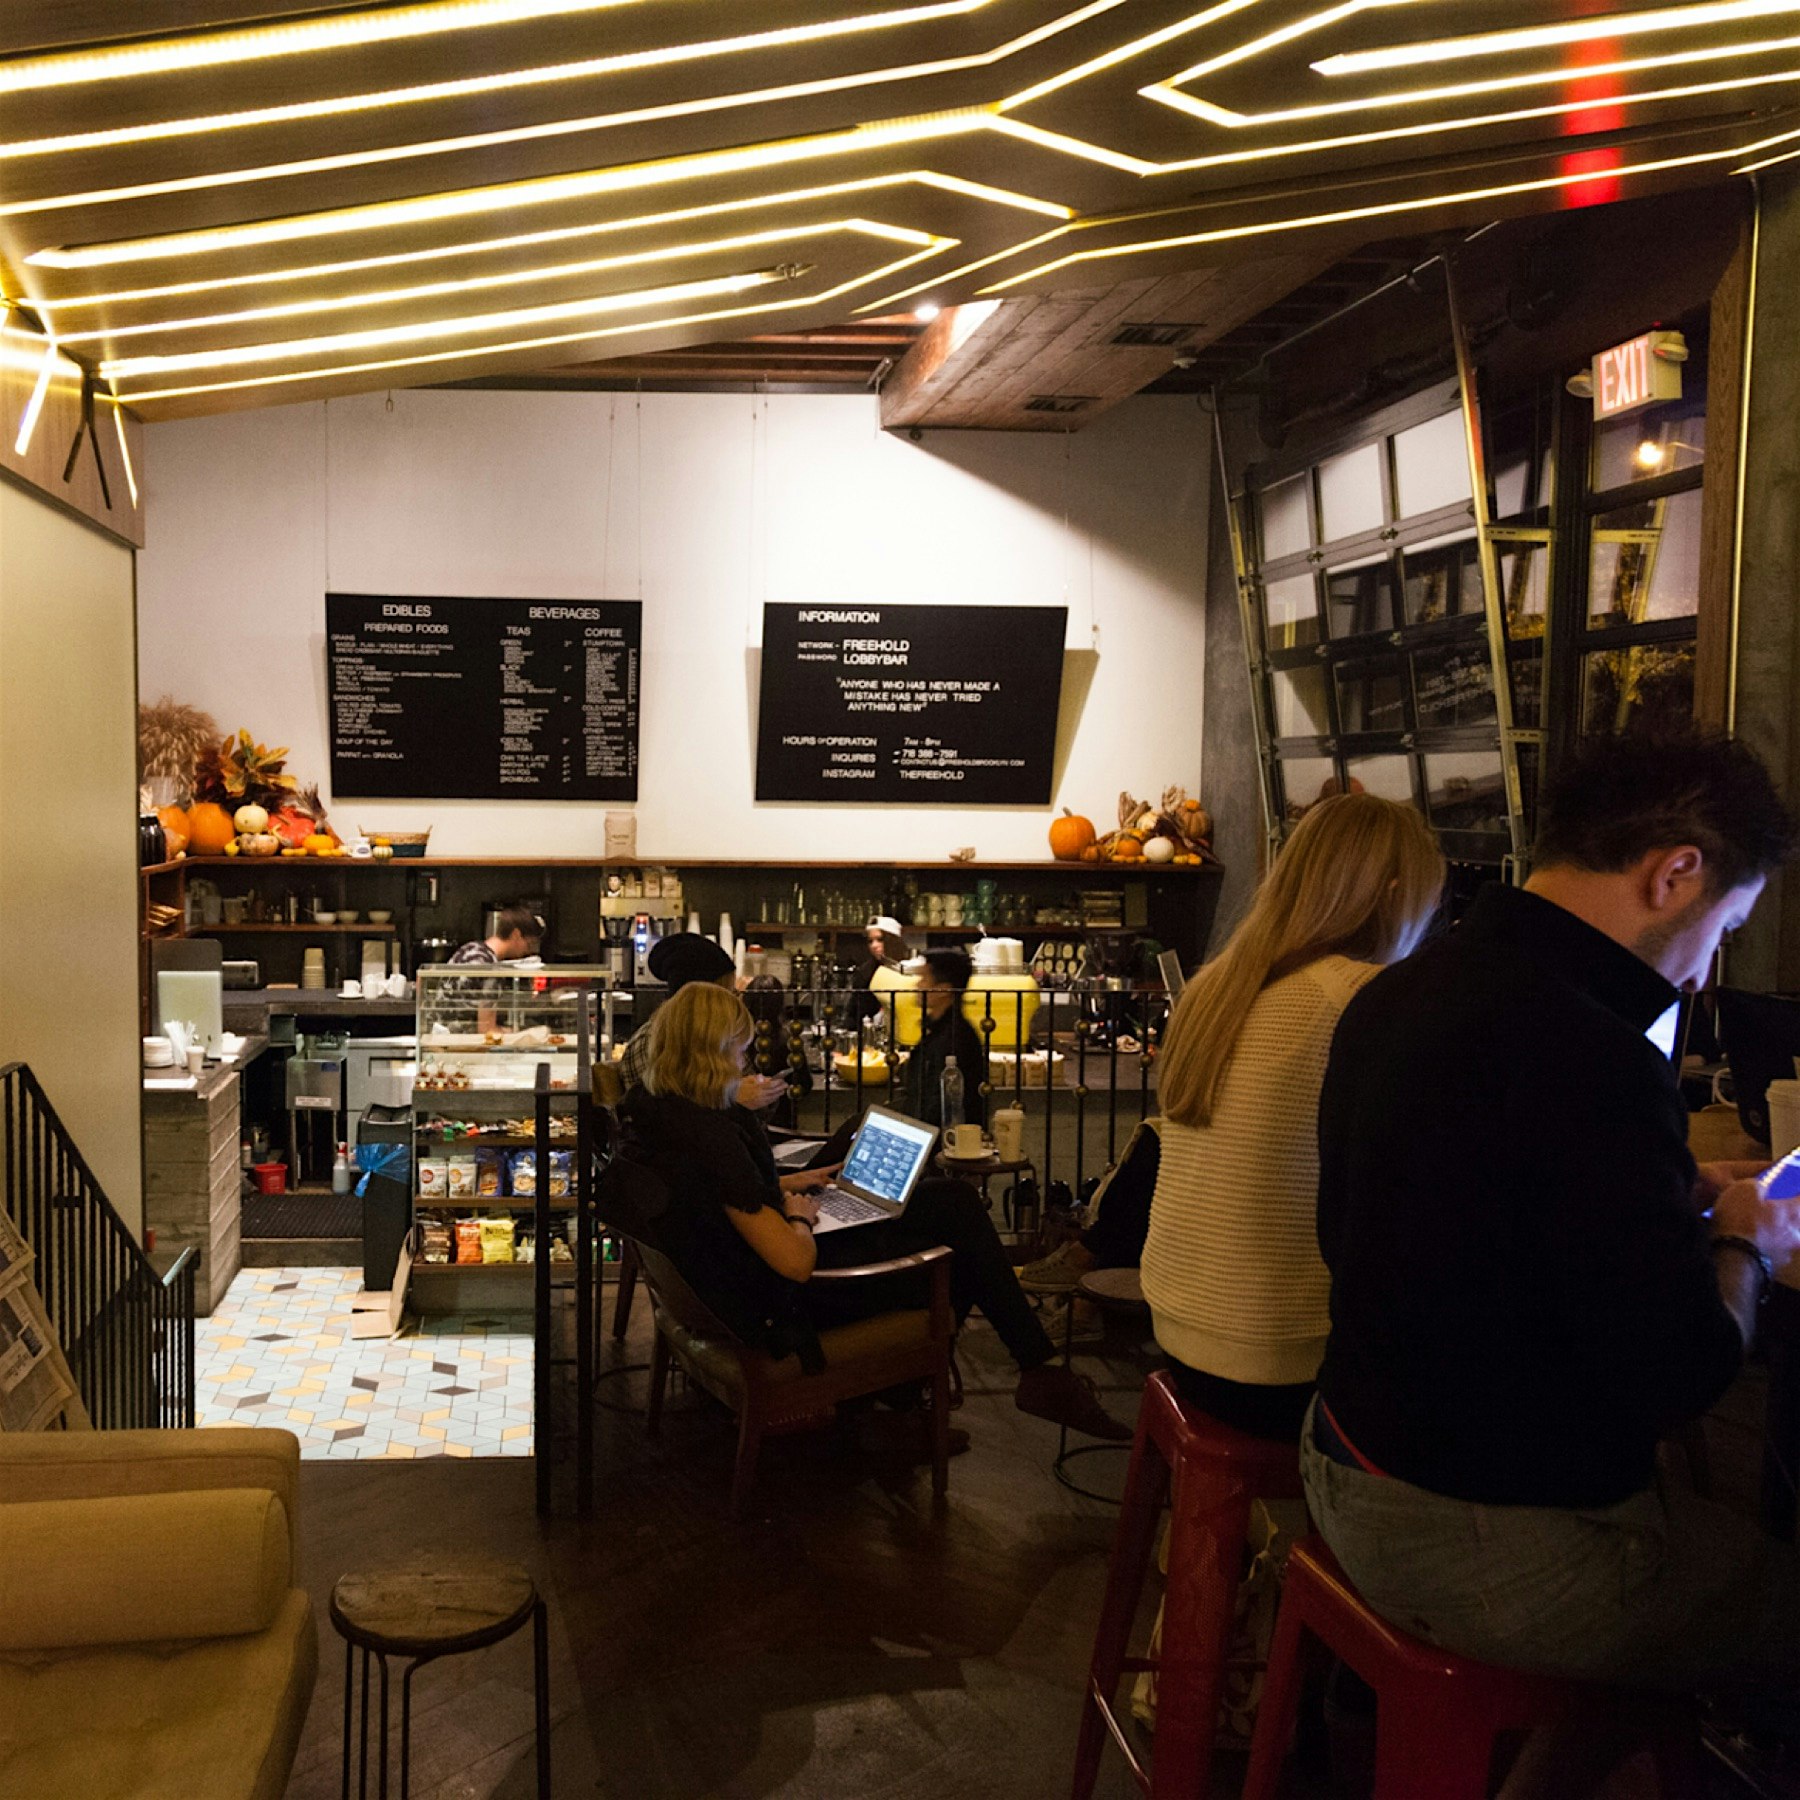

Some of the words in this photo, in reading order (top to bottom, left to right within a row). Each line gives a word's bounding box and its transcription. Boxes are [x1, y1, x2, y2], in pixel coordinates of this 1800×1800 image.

[1600, 336, 1648, 412] EXIT
[383, 603, 432, 617] EDIBLES
[529, 606, 600, 620] BEVERAGES
[798, 610, 880, 624] INFORMATION
[364, 622, 413, 633] PREPARED
[416, 624, 449, 634] FOODS
[506, 626, 532, 636] TEAS
[584, 627, 622, 638] COFFEE
[798, 641, 834, 649] NETWORK
[843, 639, 910, 652] FREEHOLD
[798, 653, 838, 661] PASSWORD
[844, 652, 908, 665] LOBBYBAR
[882, 680, 905, 690] WHO
[906, 680, 926, 690] HAS
[928, 681, 962, 691] NEVER
[964, 682, 990, 691] MADE
[993, 682, 1000, 691] A
[843, 691, 890, 701] MISTAKE
[891, 692, 911, 702] HAS
[914, 692, 948, 702] NEVER
[952, 693, 982, 702] TRIED
[847, 702, 896, 712] ANYTHING
[782, 736, 816, 746] HOURS
[826, 736, 878, 746] OPERATION
[530, 754, 550, 762] LATTE
[831, 752, 876, 763] INQUIRIES
[822, 768, 876, 778] INSTAGRAM
[899, 770, 964, 780] THEFREEHOLD
